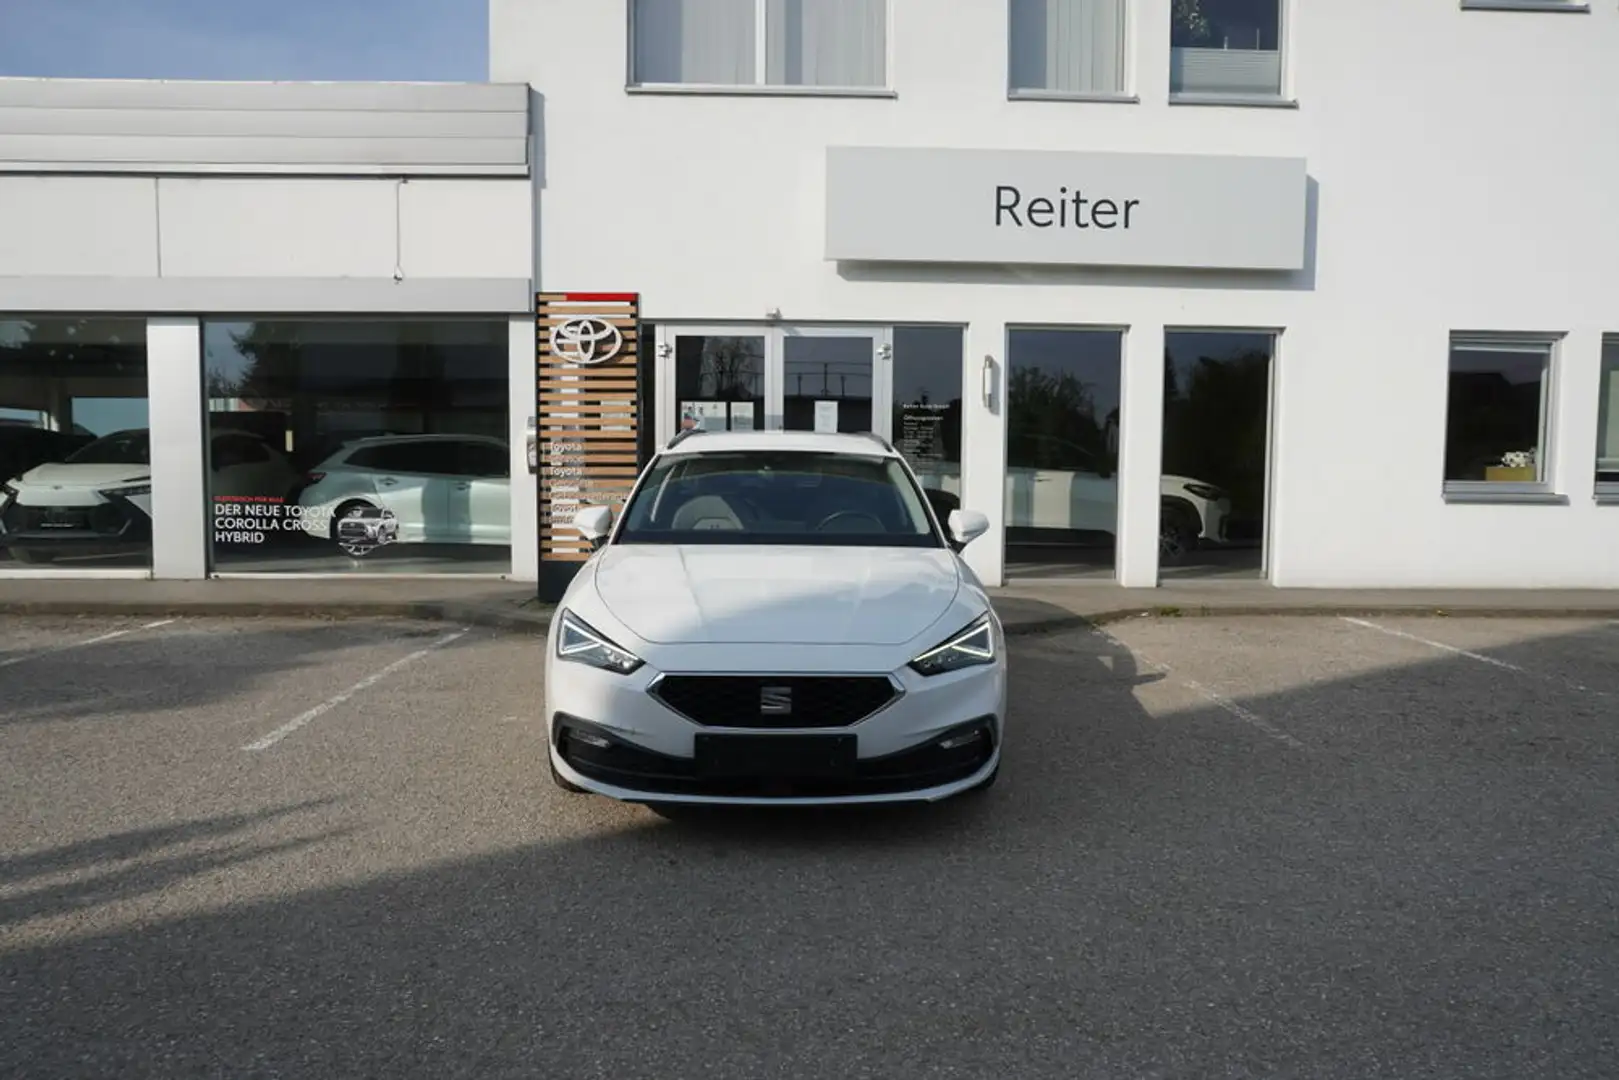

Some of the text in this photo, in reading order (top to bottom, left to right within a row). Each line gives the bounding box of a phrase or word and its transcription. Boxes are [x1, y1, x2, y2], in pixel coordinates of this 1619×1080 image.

[995, 185, 1140, 229] Reiter
[215, 504, 337, 518] DER NEUE TOYOTA
[214, 517, 328, 532] COROLLA CROSS
[215, 531, 266, 544] HYBRID
